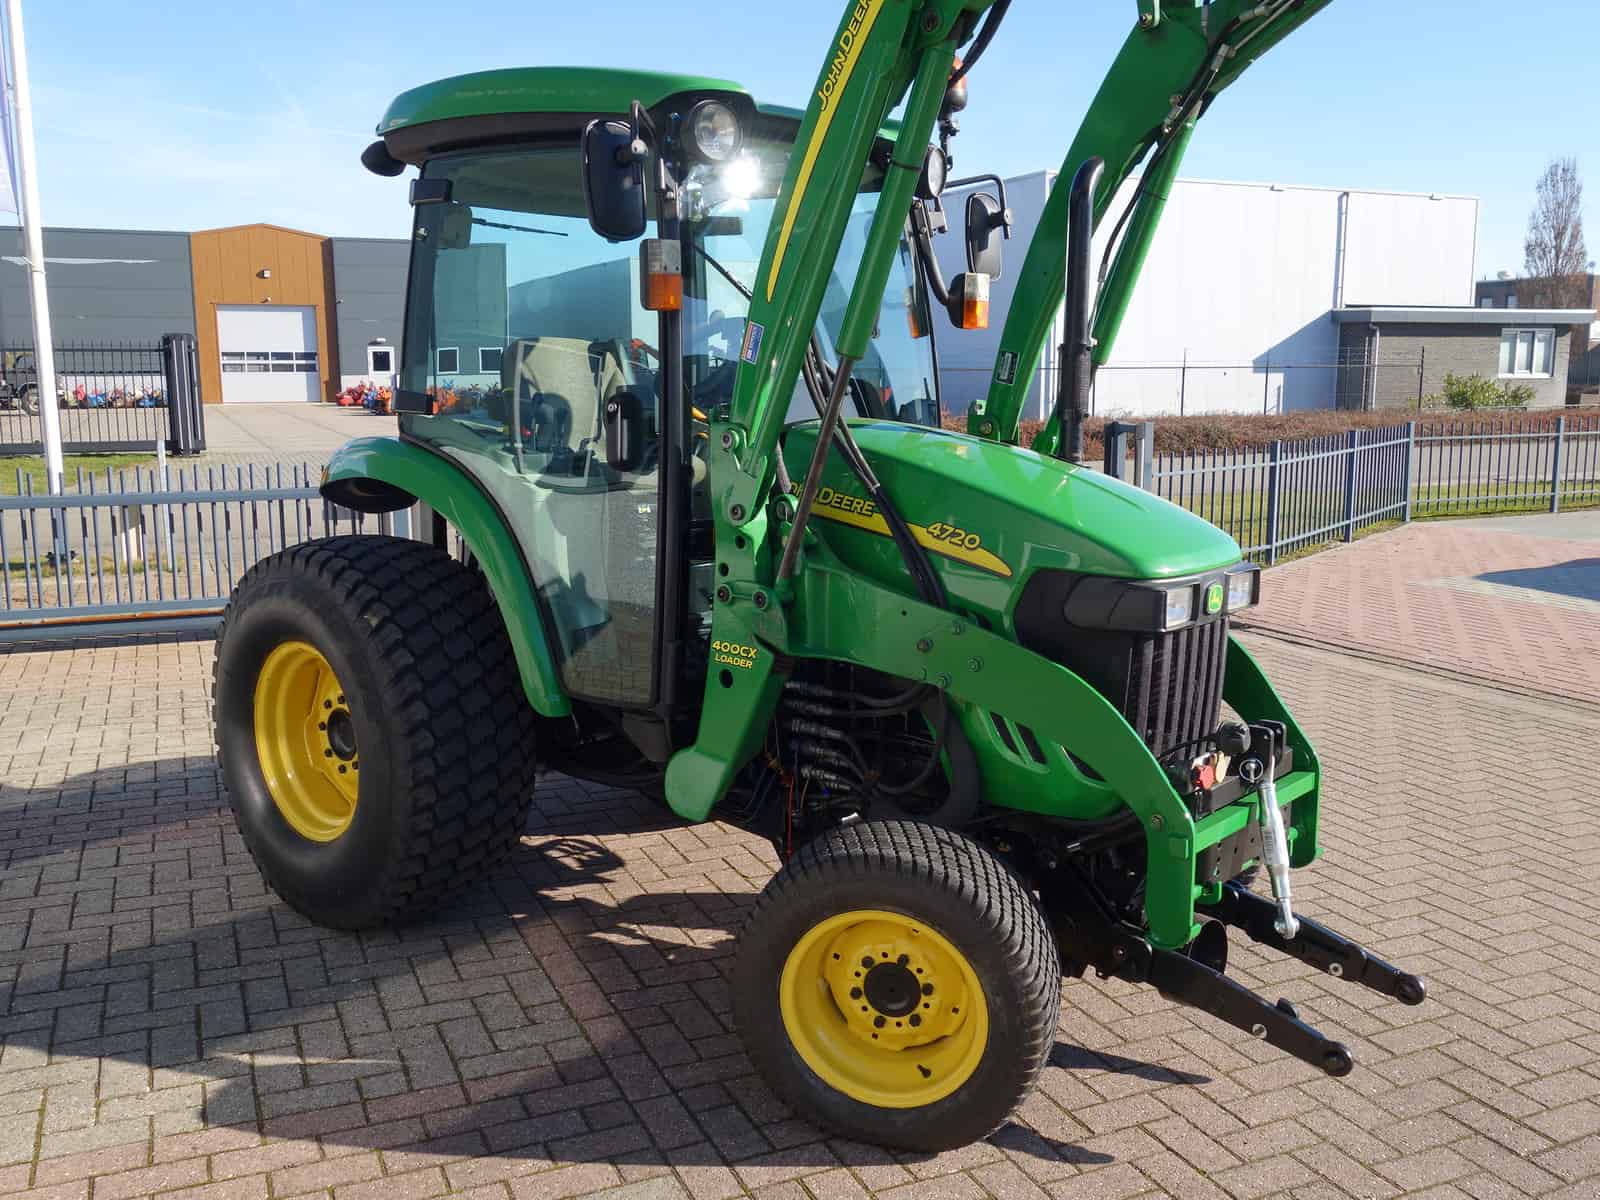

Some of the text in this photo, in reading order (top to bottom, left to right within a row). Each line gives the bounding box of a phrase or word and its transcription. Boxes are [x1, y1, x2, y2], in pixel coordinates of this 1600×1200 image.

[818, 0, 872, 111] JOHN DEE
[816, 487, 875, 516] DEERE
[927, 522, 980, 549] 4720
[712, 640, 758, 659] 400CX
[714, 653, 753, 669] LOADER
